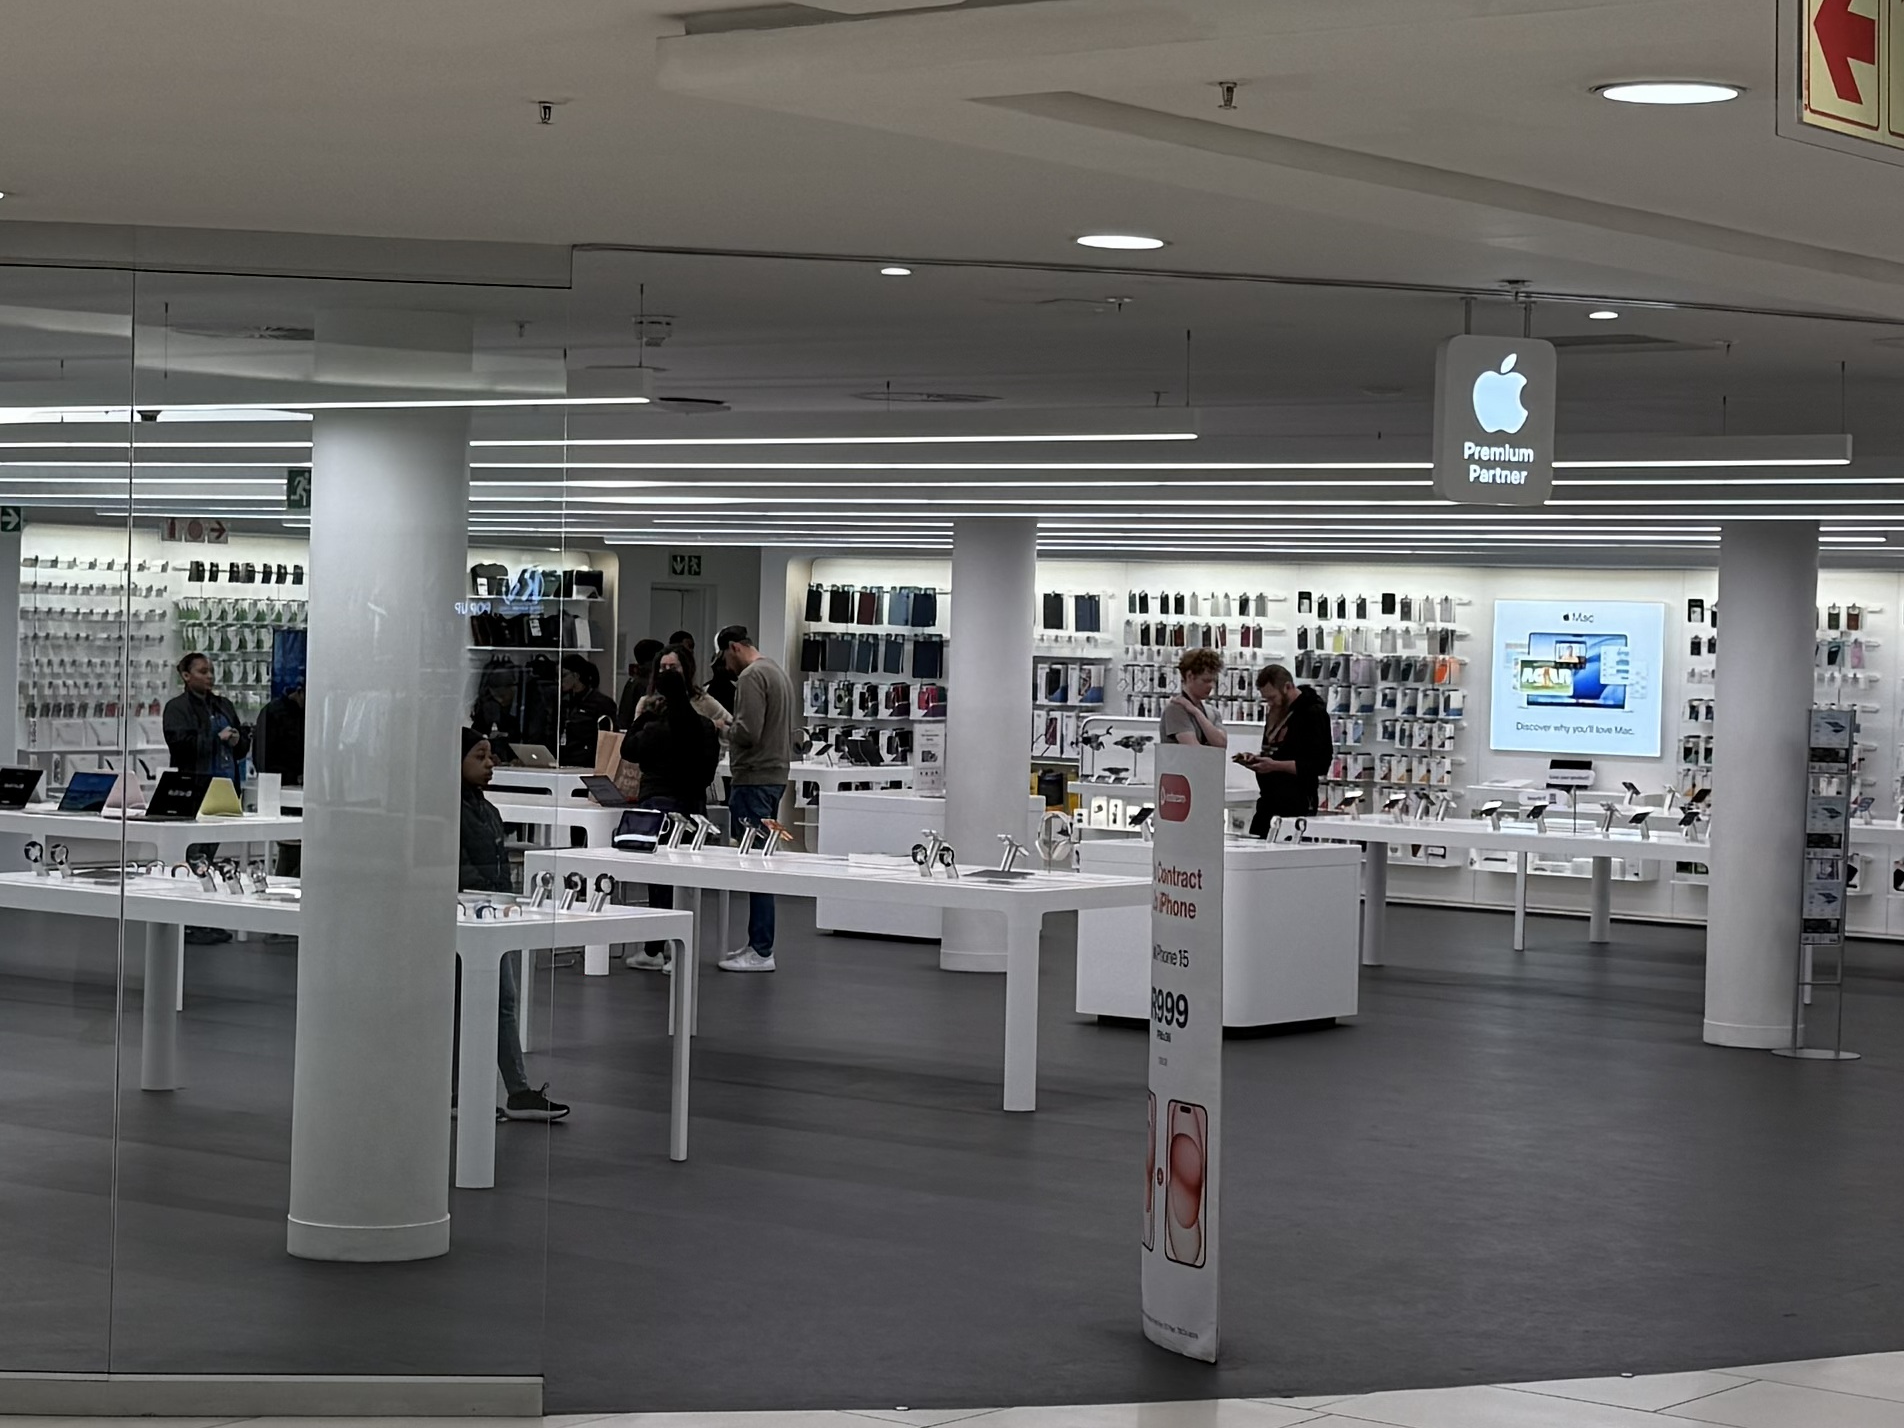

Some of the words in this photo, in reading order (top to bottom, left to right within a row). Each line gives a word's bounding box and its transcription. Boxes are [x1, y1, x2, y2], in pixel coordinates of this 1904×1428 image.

[1463, 441, 1535, 463] Premium
[1469, 464, 1528, 485] Partner
[1151, 985, 1189, 1029] R999
